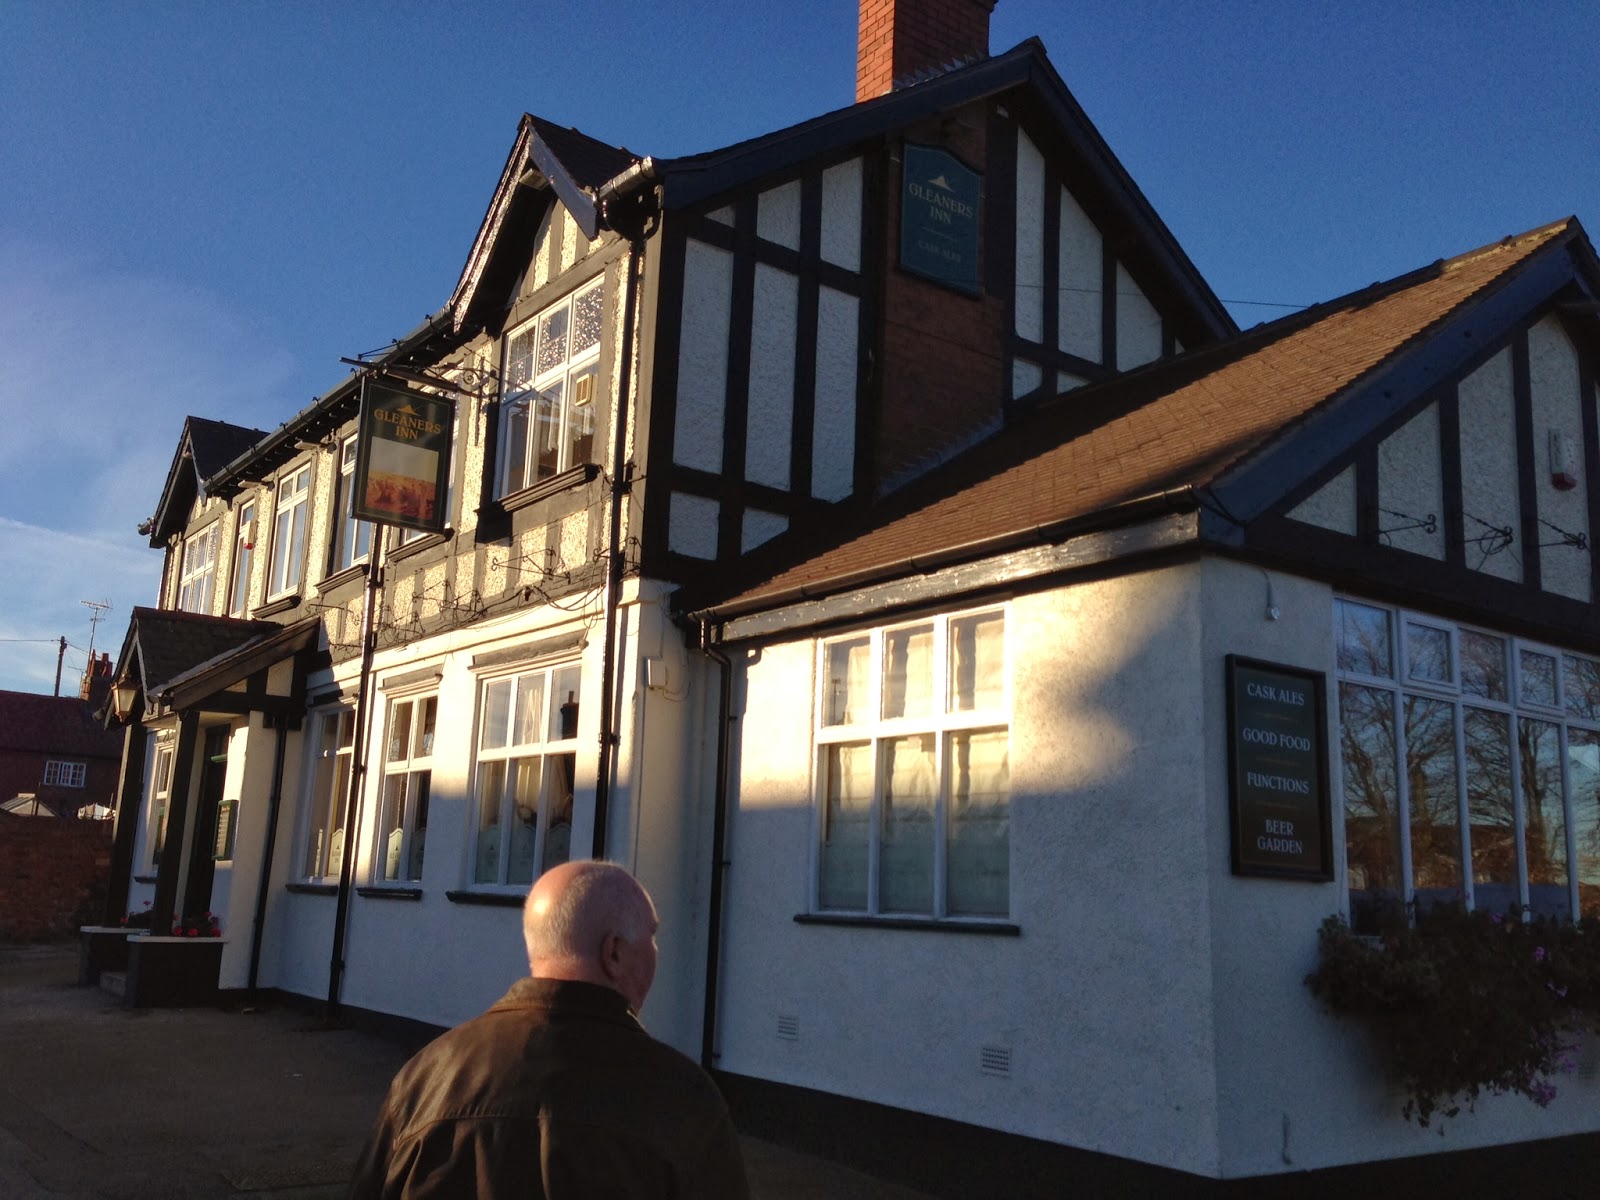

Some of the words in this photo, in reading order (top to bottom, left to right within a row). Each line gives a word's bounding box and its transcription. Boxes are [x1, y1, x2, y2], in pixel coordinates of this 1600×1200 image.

[909, 182, 974, 218] GLEANERS
[930, 206, 952, 224] INN
[373, 408, 441, 435] GLEANERS
[395, 425, 419, 440] INN
[1247, 682, 1277, 701] CASK
[1279, 689, 1305, 706] ALES
[1242, 727, 1278, 746] GOOD
[1279, 733, 1311, 751] FOOD
[1247, 771, 1309, 794] FUNCTIONS
[1265, 818, 1294, 836] BEER
[1257, 836, 1303, 855] GARDEN
